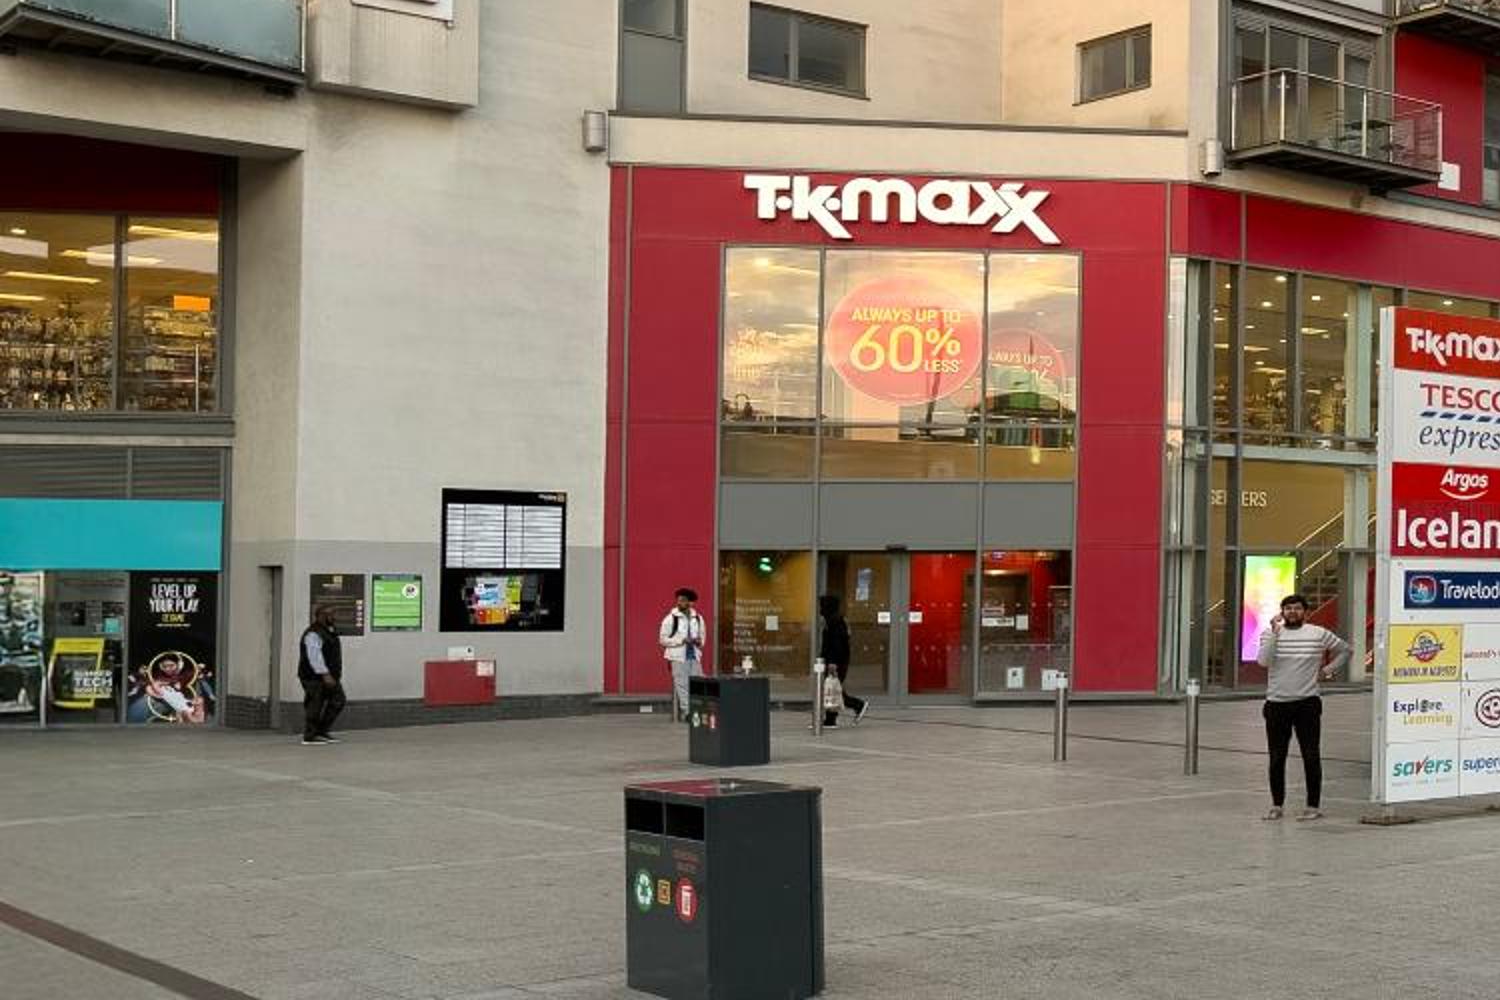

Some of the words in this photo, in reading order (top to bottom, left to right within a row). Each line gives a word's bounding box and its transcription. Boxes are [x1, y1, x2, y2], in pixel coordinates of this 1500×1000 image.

[850, 307, 912, 323] ALWAYS
[916, 308, 937, 324] UP
[940, 309, 961, 324] TO
[849, 325, 961, 374] 60%
[1440, 468, 1489, 492] Argos
[151, 584, 181, 600] LEVEL
[183, 584, 197, 599] UP
[73, 677, 113, 688] TECH
[1392, 755, 1453, 777] savers
